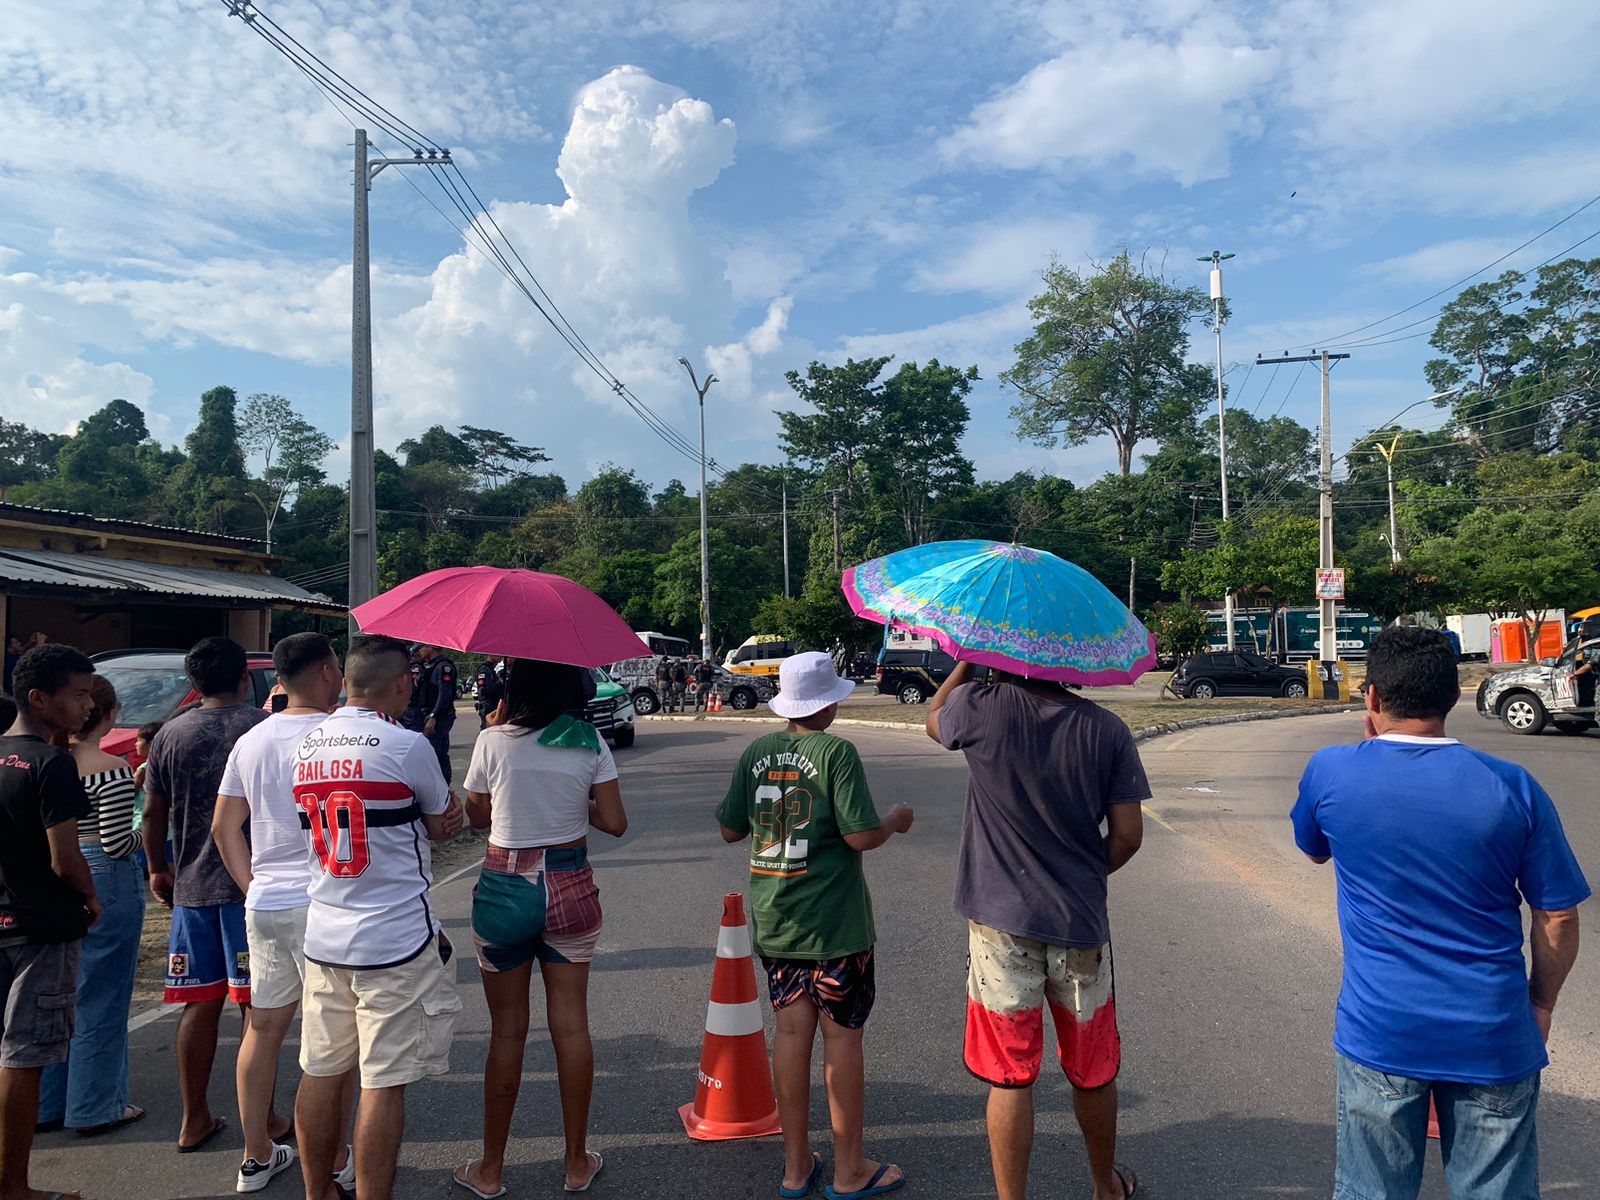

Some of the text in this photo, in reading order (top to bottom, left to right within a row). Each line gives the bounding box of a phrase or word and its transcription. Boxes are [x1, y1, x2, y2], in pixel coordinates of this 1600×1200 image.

[302, 733, 380, 750] Sportsbet.io
[6, 754, 31, 770] Deus
[298, 758, 364, 783] BAILOSA
[751, 755, 771, 779] NEW
[797, 755, 819, 780] CITY
[300, 790, 371, 878] 10
[752, 785, 813, 859] 32
